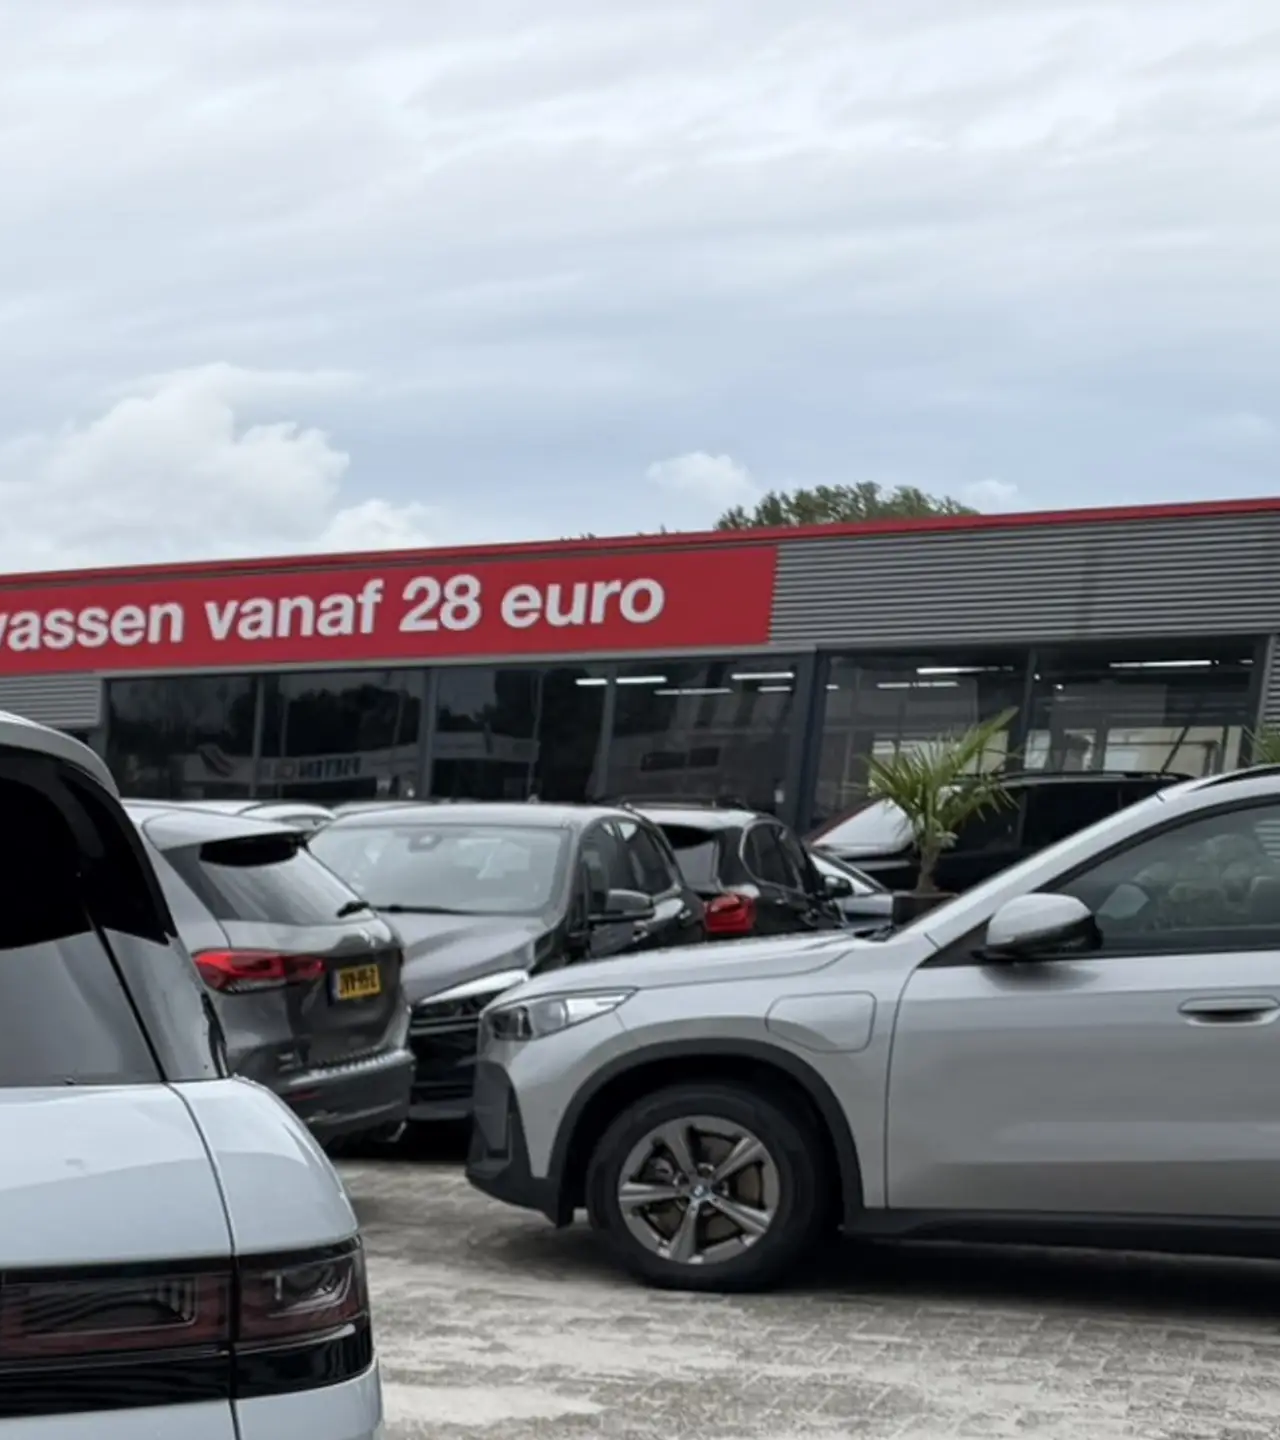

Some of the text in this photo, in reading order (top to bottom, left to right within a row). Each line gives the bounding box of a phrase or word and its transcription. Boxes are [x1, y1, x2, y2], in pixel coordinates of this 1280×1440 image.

[204, 579, 385, 640] vanaf
[399, 574, 481, 632] 28
[501, 578, 665, 629] euro
